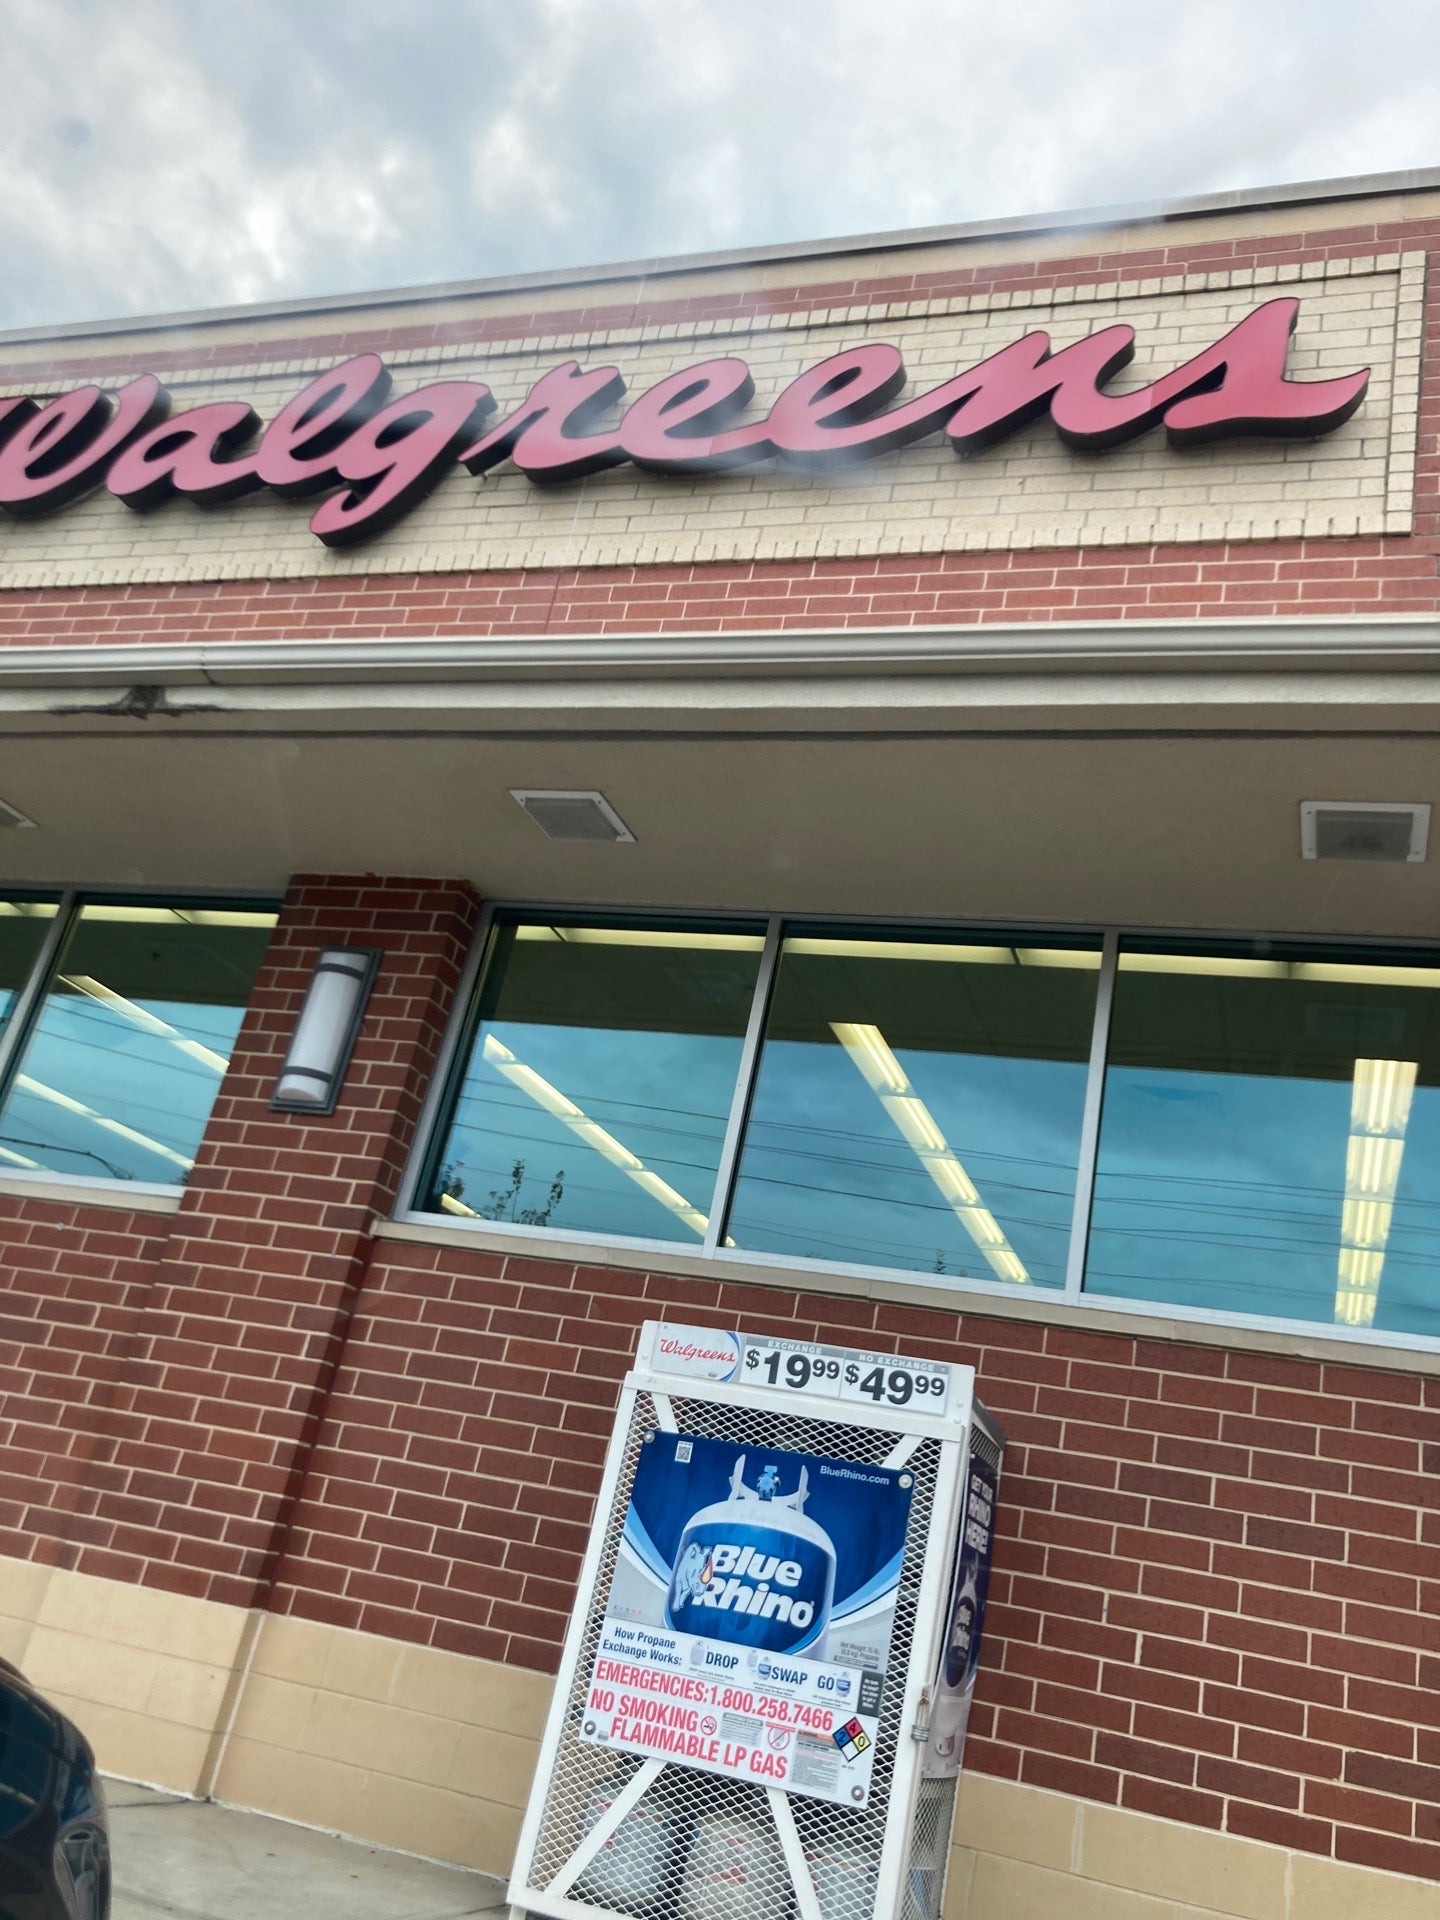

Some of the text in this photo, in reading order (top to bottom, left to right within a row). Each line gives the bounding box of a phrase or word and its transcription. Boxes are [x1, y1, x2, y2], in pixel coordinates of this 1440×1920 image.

[660, 1339, 736, 1361] Walgreens
[768, 1340, 823, 1356] EXCHANGE
[859, 1354, 935, 1372] NO EXCHANGE
[820, 1465, 890, 1486] BlueRhino.com
[711, 1543, 803, 1588] Blue
[691, 1577, 814, 1628] Rhino
[614, 1626, 676, 1649] How Propane
[602, 1639, 682, 1666] Exchange Works:
[705, 1651, 739, 1670] DROP
[771, 1666, 808, 1685] SWAP
[817, 1675, 835, 1691] GO
[590, 1688, 614, 1713] NO
[618, 1695, 699, 1732] SMOKING
[838, 1731, 847, 1743] 2
[849, 1722, 856, 1734] 4
[610, 1717, 720, 1763] FLAMMABLE
[723, 1743, 747, 1768] LP
[750, 1750, 788, 1779] GAS
[857, 1735, 866, 1748] 0
